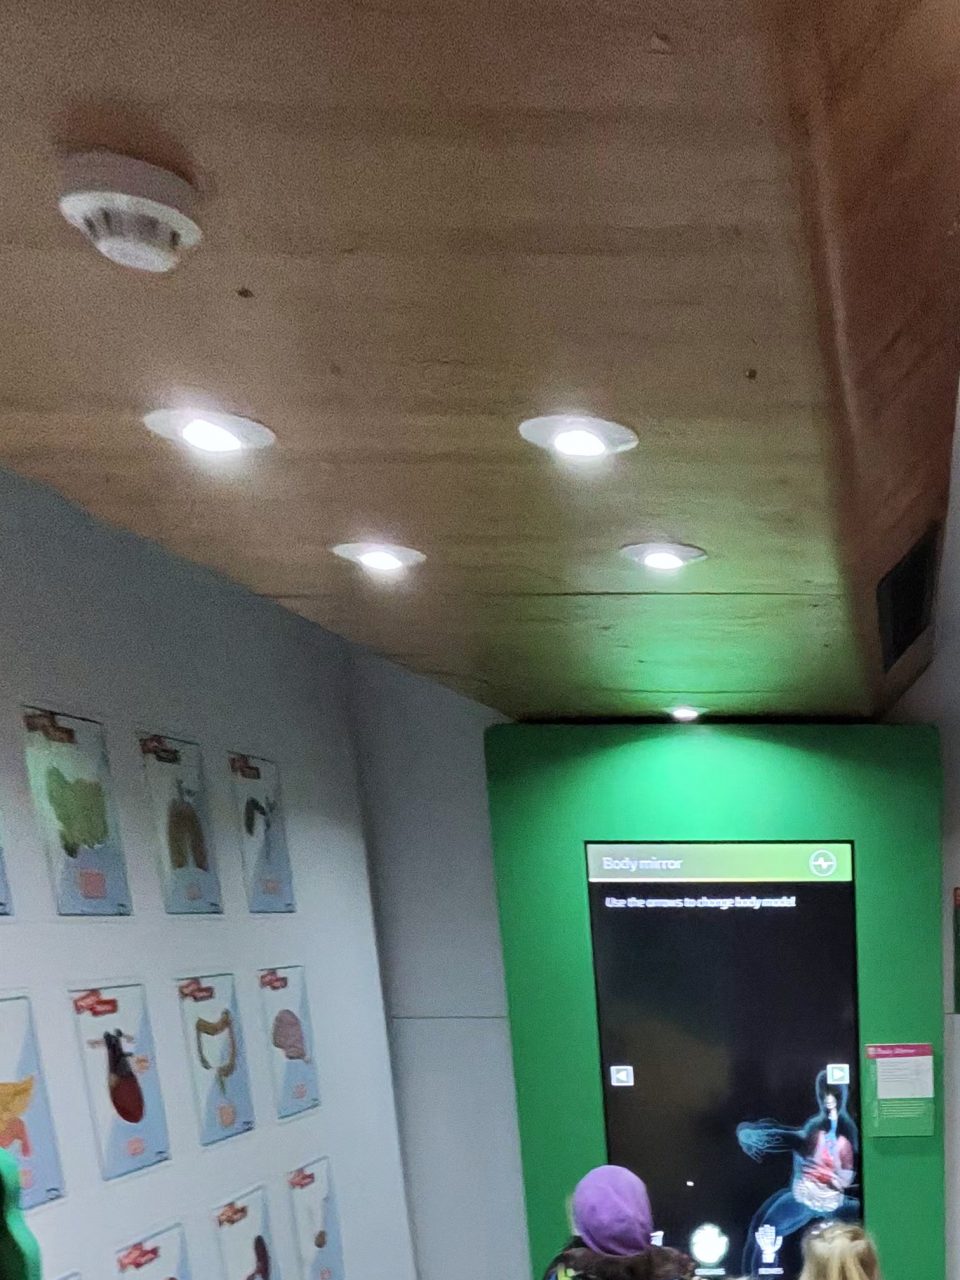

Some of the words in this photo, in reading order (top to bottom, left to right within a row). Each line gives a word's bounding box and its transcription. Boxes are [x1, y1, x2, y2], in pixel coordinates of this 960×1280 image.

[602, 857, 638, 872] Body
[639, 856, 683, 869] mirror
[605, 897, 627, 907] Use
[627, 897, 645, 907] the
[684, 897, 696, 907] to
[697, 896, 735, 910] change
[735, 896, 761, 910] body
